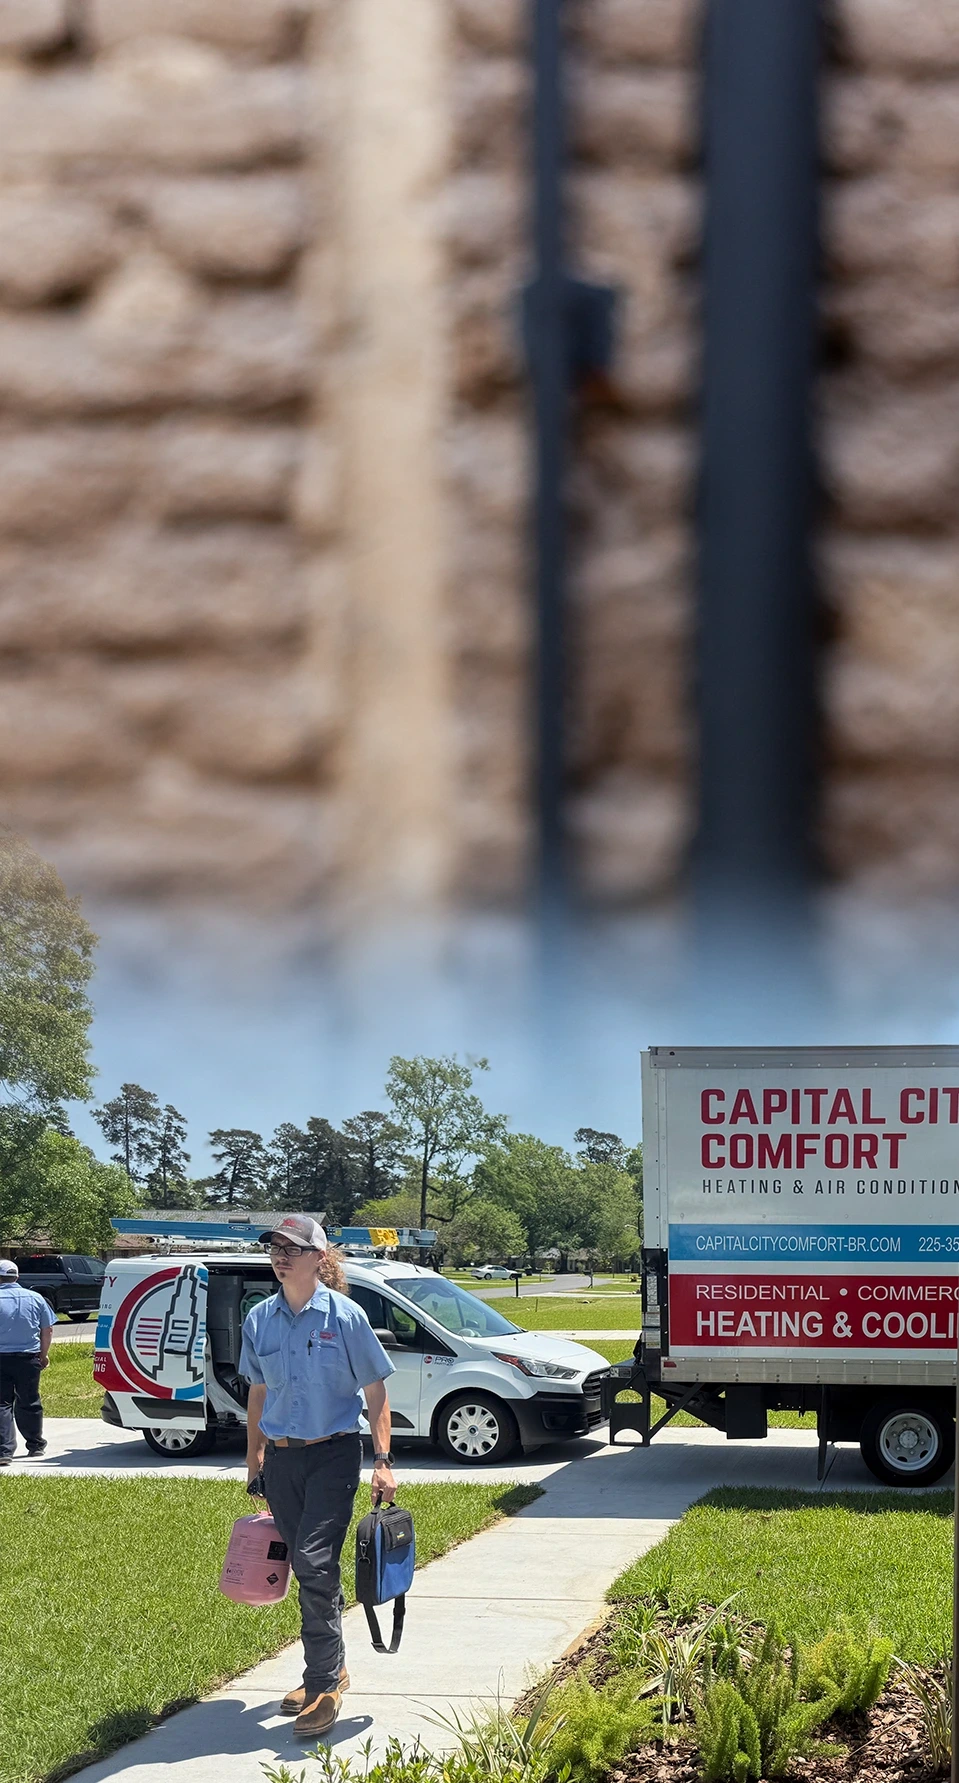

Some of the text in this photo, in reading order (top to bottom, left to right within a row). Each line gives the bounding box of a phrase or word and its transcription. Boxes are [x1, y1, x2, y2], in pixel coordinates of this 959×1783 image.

[701, 1087, 959, 1125] CAPITAL CIT
[701, 1132, 907, 1170] COMFORT
[702, 1179, 782, 1194] HEATING
[793, 1179, 804, 1194] &
[814, 1179, 845, 1195] AIR
[696, 1235, 959, 1253] CAPITALCITYCOMFORT-BR.COM 225-35
[696, 1285, 830, 1300] RESIDENTIAL
[696, 1311, 823, 1338] HEATING
[832, 1311, 853, 1338] &
